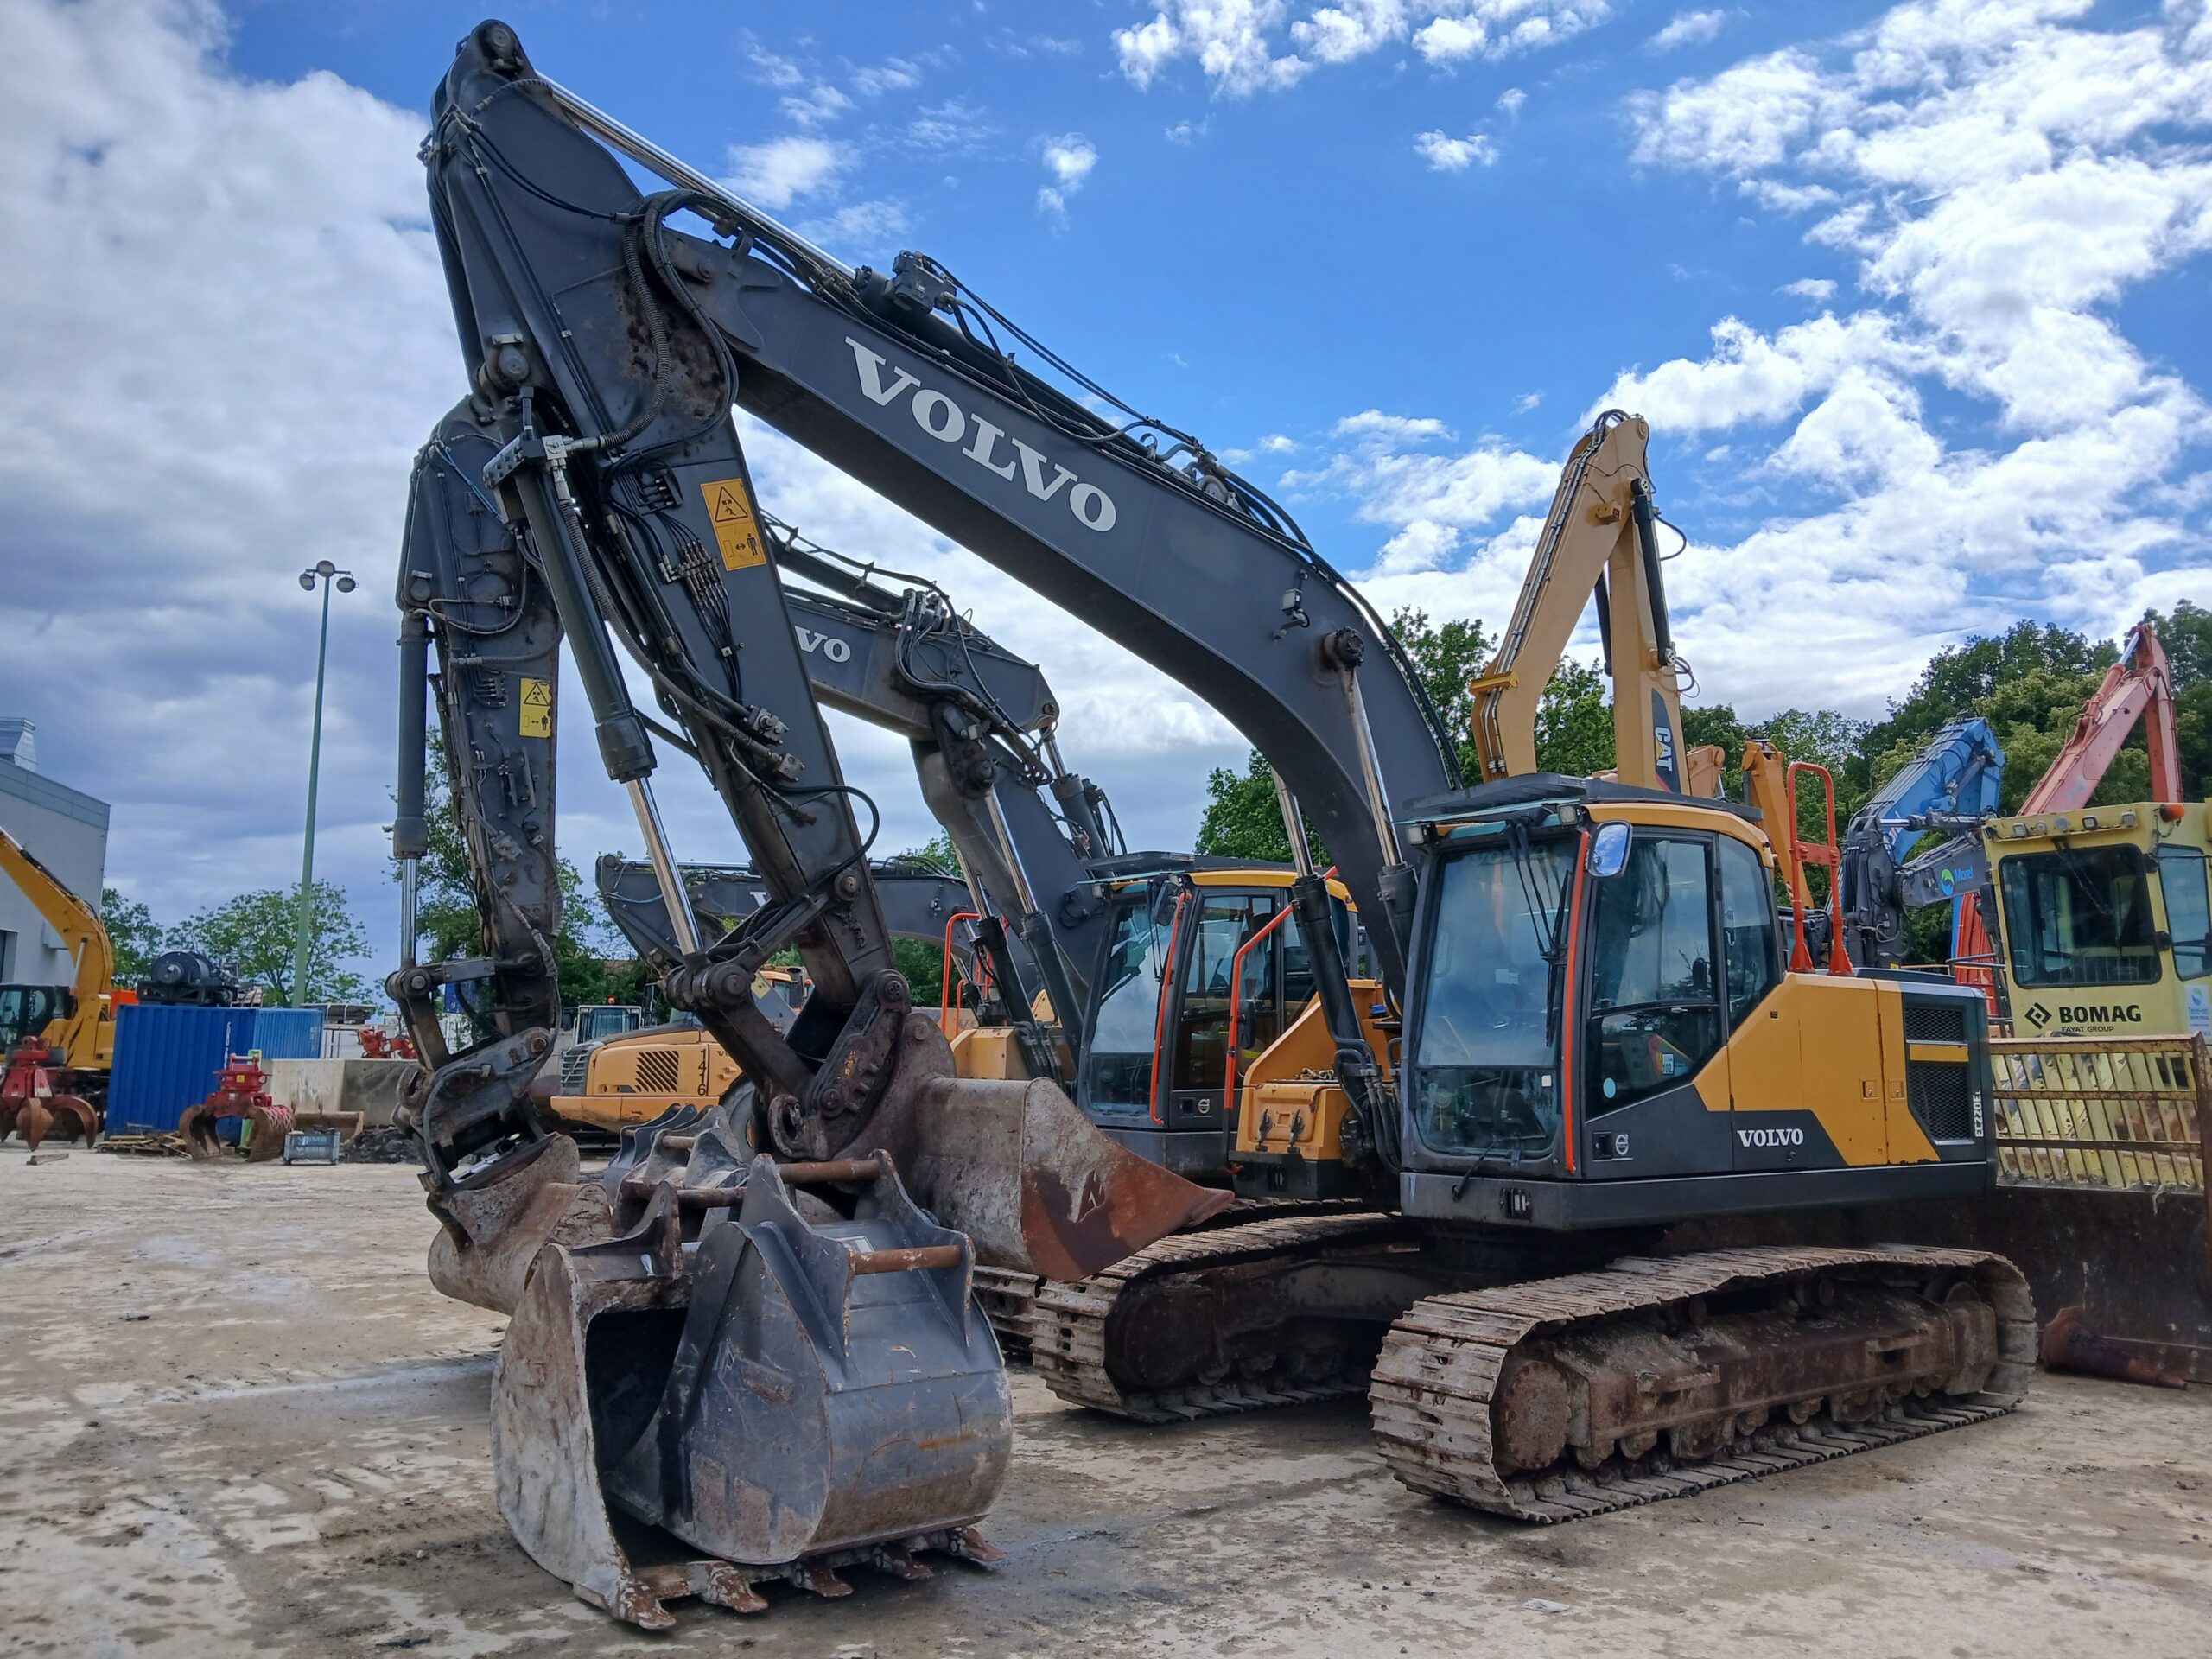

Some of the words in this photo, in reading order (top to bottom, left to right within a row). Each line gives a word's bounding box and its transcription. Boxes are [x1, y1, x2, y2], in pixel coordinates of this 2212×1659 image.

[844, 335, 1116, 532] VOLVO
[1655, 727, 1673, 772] CAT
[2058, 1004, 2142, 1024] BOMAG
[697, 1048, 707, 1096] 1416
[1737, 1128, 1804, 1147] VOLVO
